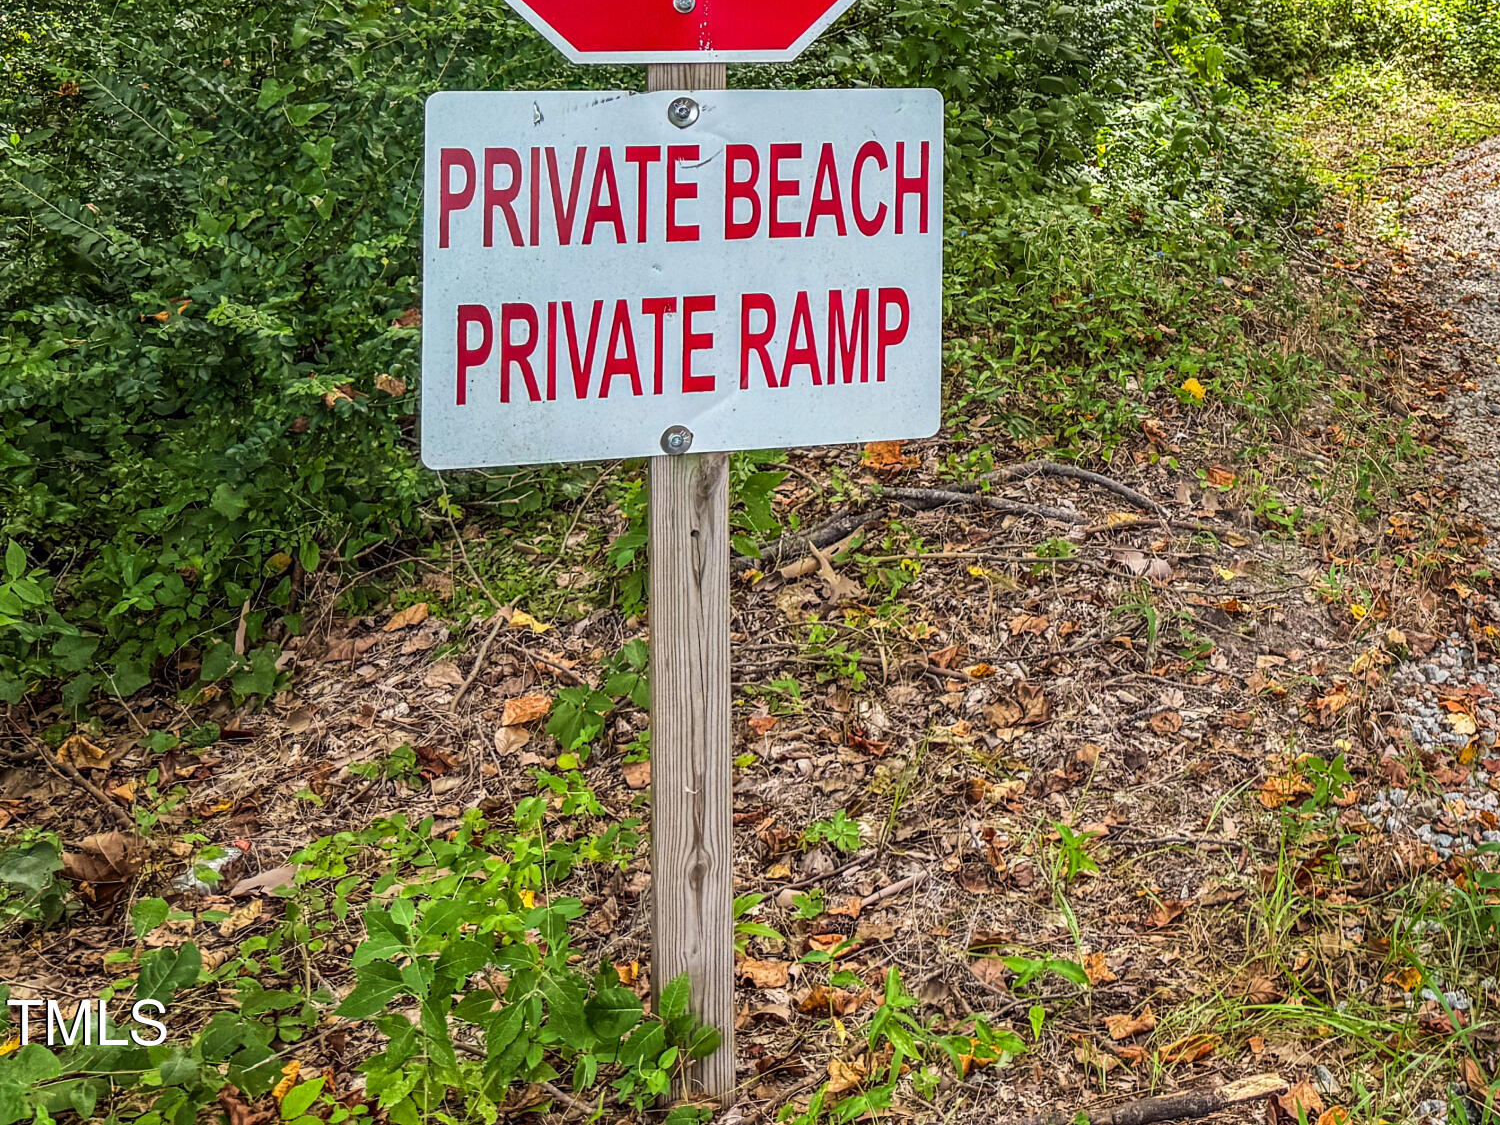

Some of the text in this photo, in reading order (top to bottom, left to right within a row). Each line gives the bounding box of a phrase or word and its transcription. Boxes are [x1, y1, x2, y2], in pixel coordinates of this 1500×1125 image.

[439, 140, 930, 249] PRIVATE BEACH
[456, 286, 911, 406] PRIVATE RAMP
